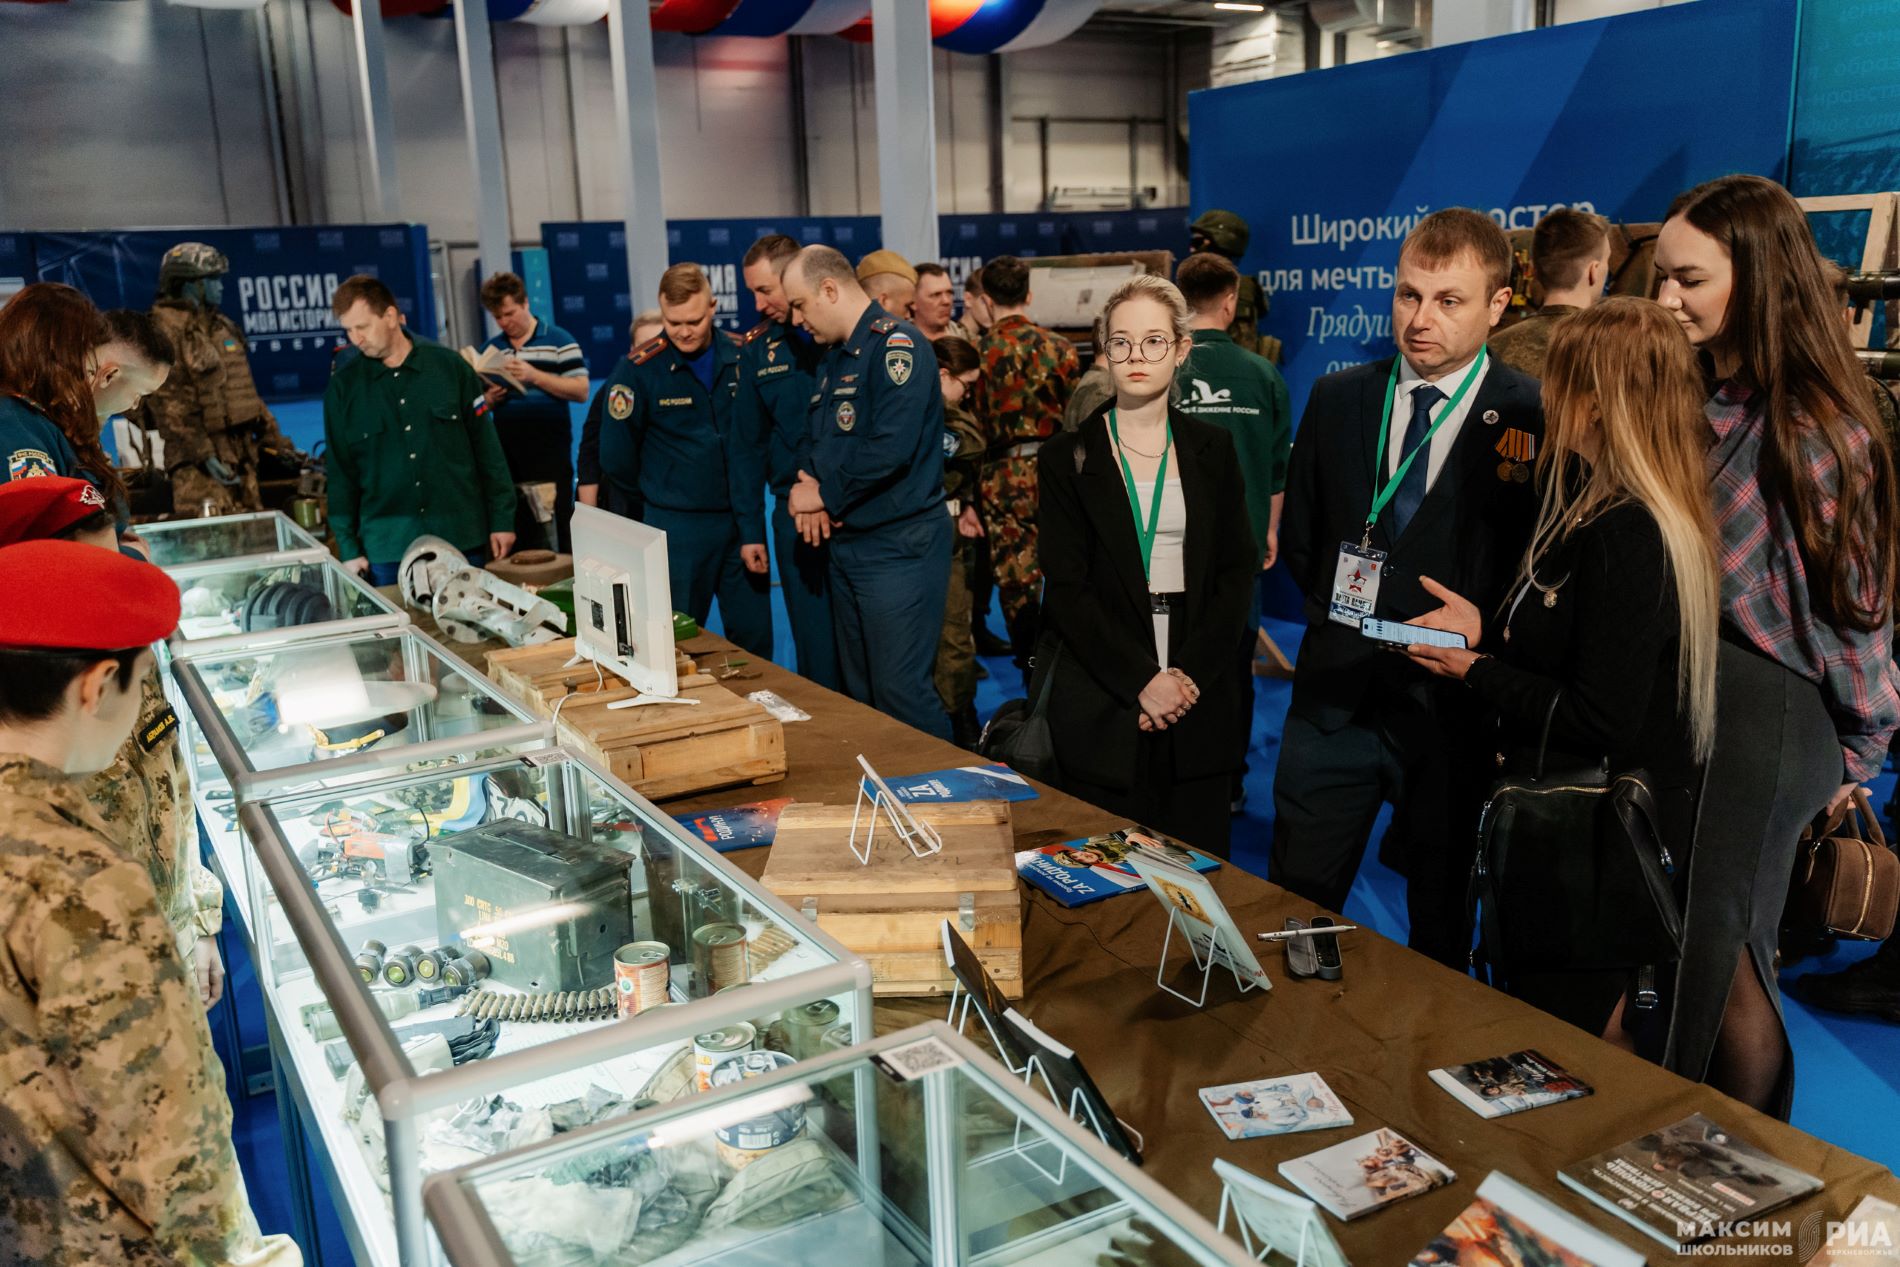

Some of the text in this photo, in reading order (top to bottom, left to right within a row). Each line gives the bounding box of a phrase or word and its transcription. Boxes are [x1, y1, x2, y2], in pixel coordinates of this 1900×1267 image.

[1291, 205, 1430, 251] Широкий
[1258, 269, 1303, 296] для
[243, 311, 278, 334] МОЯ
[1306, 305, 1394, 344] Грядущ
[1606, 1161, 1656, 1193] ПОМОЩЬ
